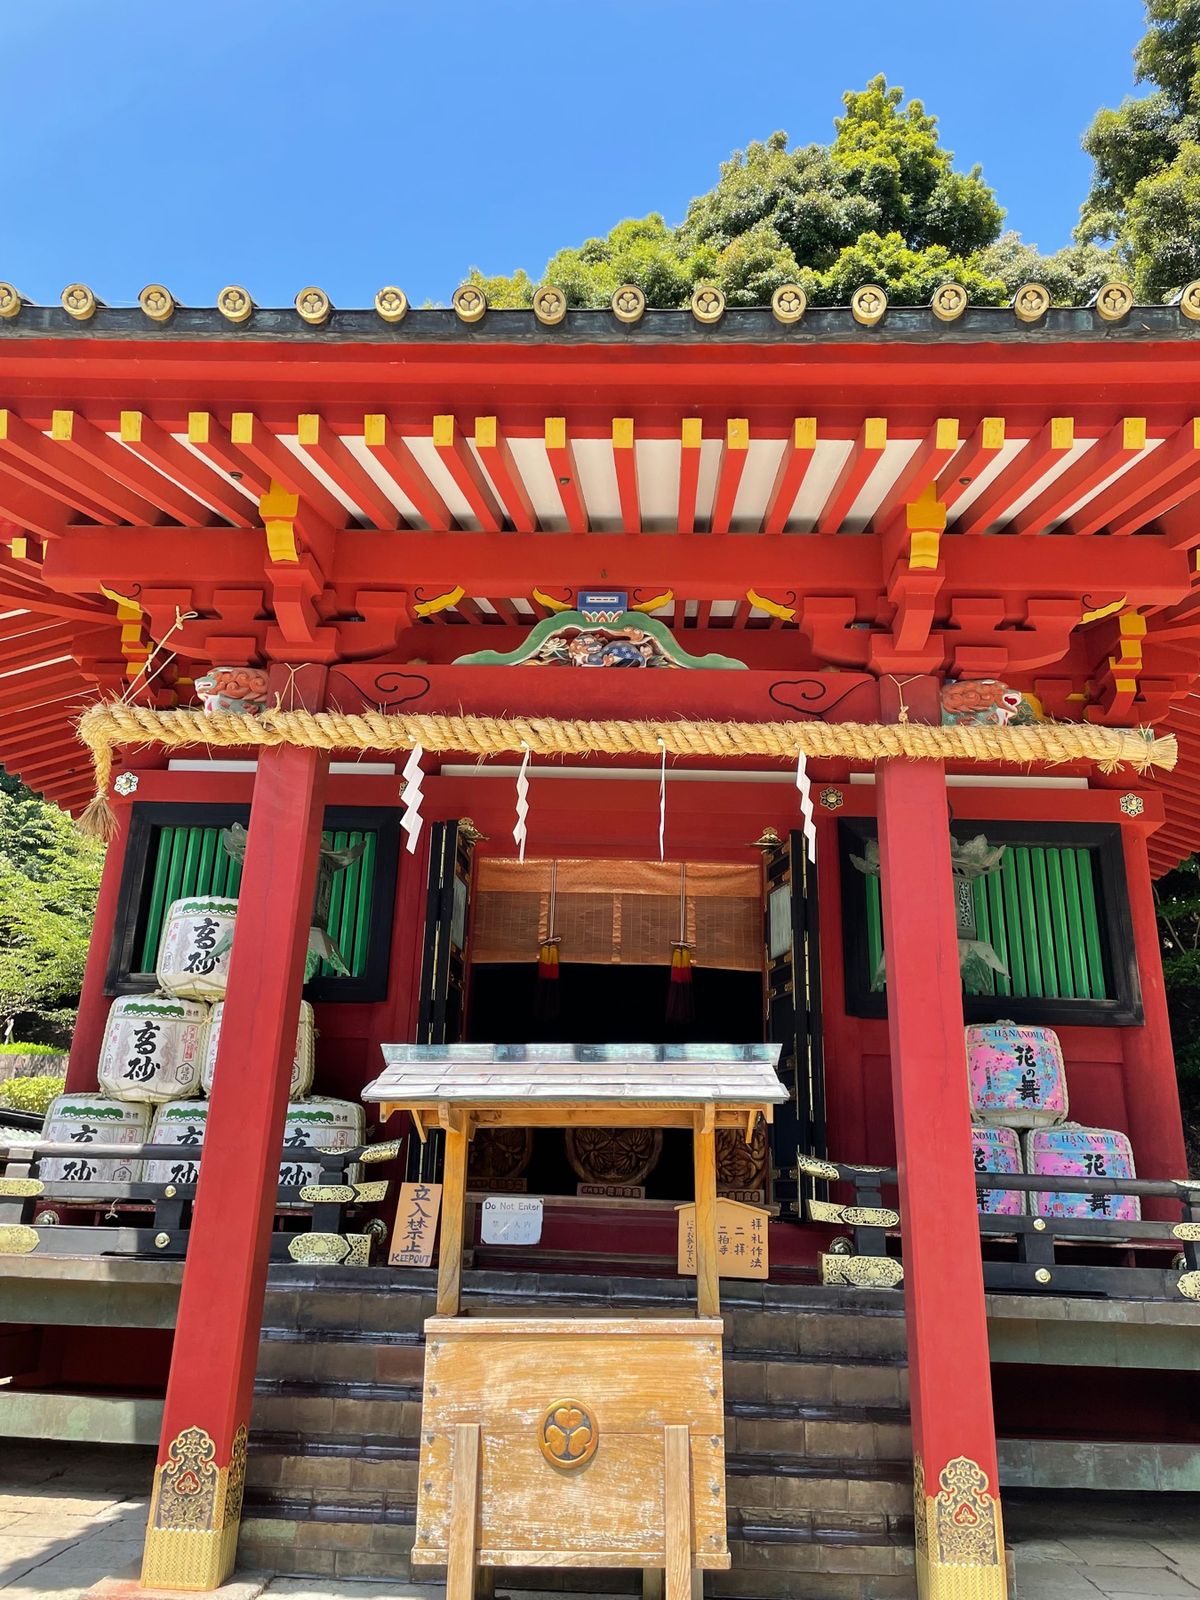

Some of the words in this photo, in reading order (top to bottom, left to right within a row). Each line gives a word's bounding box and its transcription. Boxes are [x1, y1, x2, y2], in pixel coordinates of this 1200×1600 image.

[123, 1020, 160, 1082] 高砂
[1014, 1045, 1040, 1103] 花の舞
[973, 1132, 1001, 1141] NOMAI
[485, 1202, 496, 1210] Do
[500, 1202, 514, 1210] Not
[518, 1202, 540, 1211] Enter
[1083, 1153, 1111, 1215] 花舞
[401, 1185, 432, 1253] 立入禁止
[717, 1225, 730, 1256] 二拍手
[750, 1218, 764, 1268] 拝礼作法
